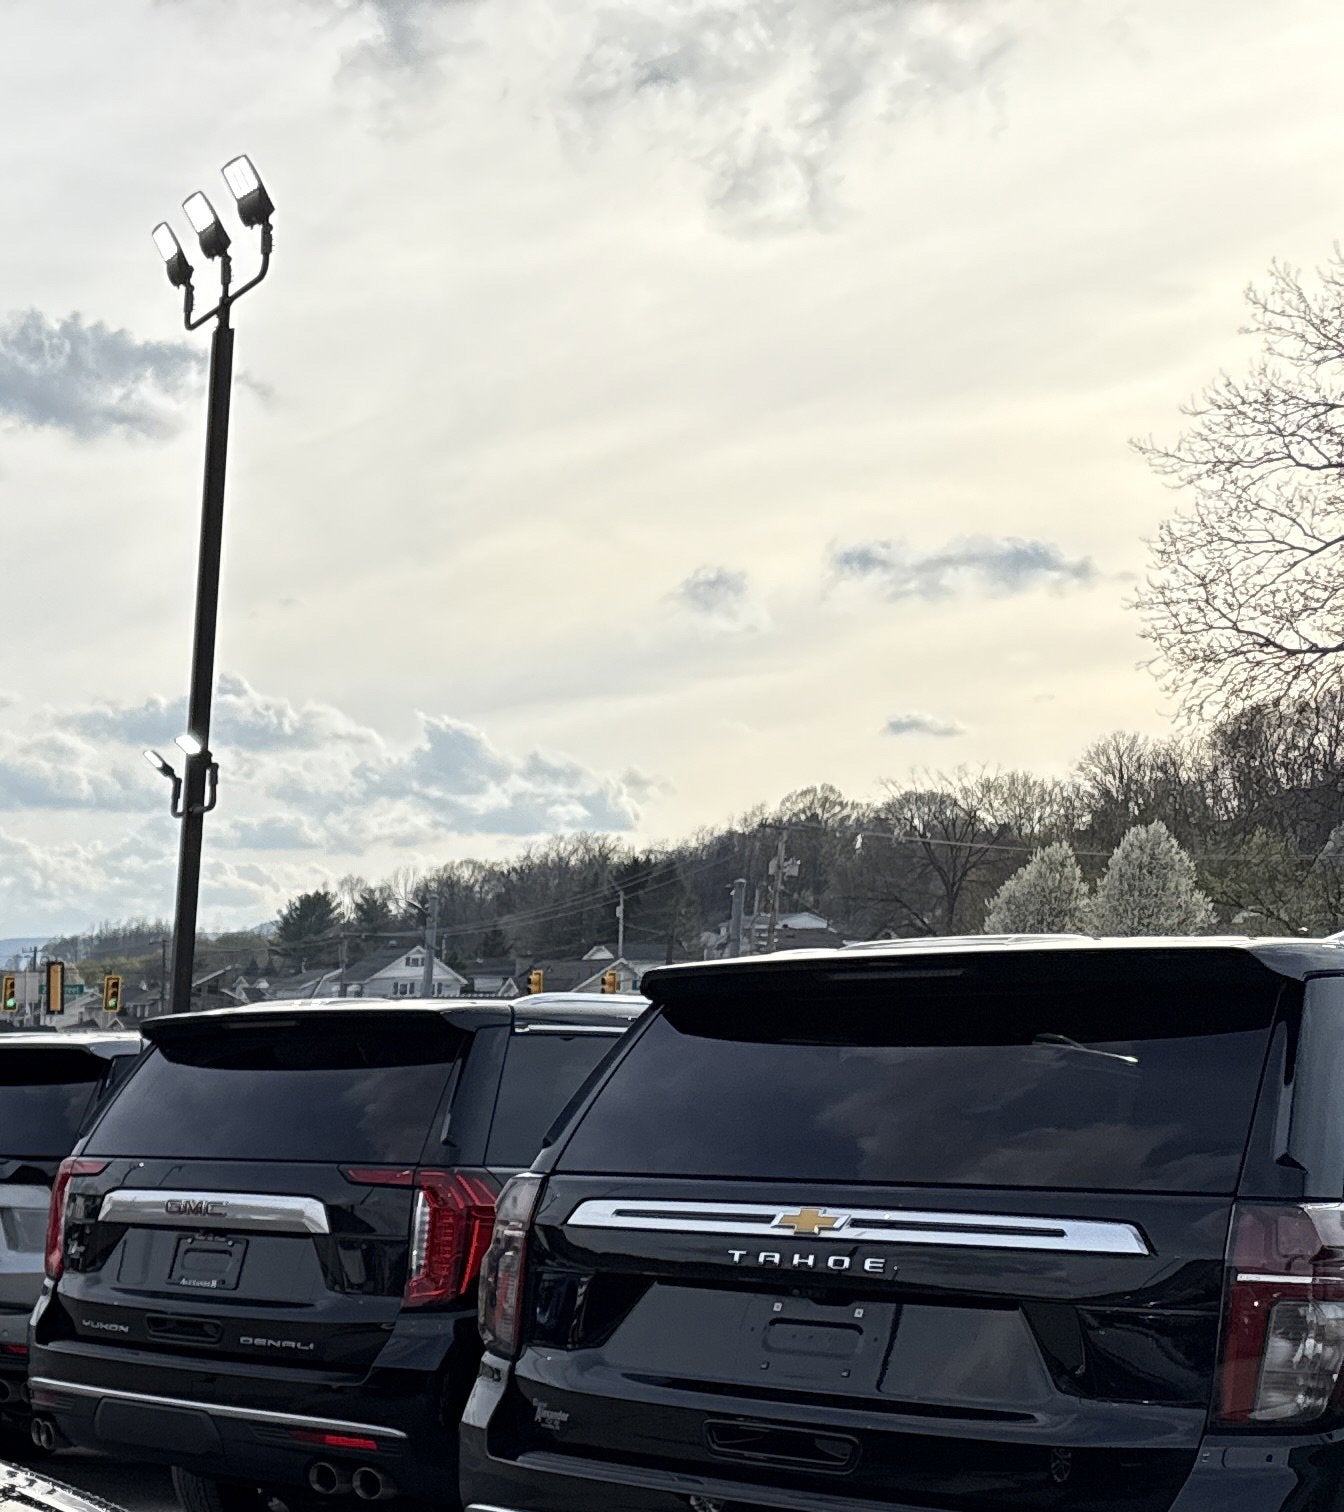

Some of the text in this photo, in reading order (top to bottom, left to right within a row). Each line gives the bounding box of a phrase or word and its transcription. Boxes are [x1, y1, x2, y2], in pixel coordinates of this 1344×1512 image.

[164, 1198, 227, 1218] GMC
[727, 1249, 888, 1274] TAHOE
[81, 1318, 130, 1334] YUKON
[239, 1336, 314, 1351] DENALI
